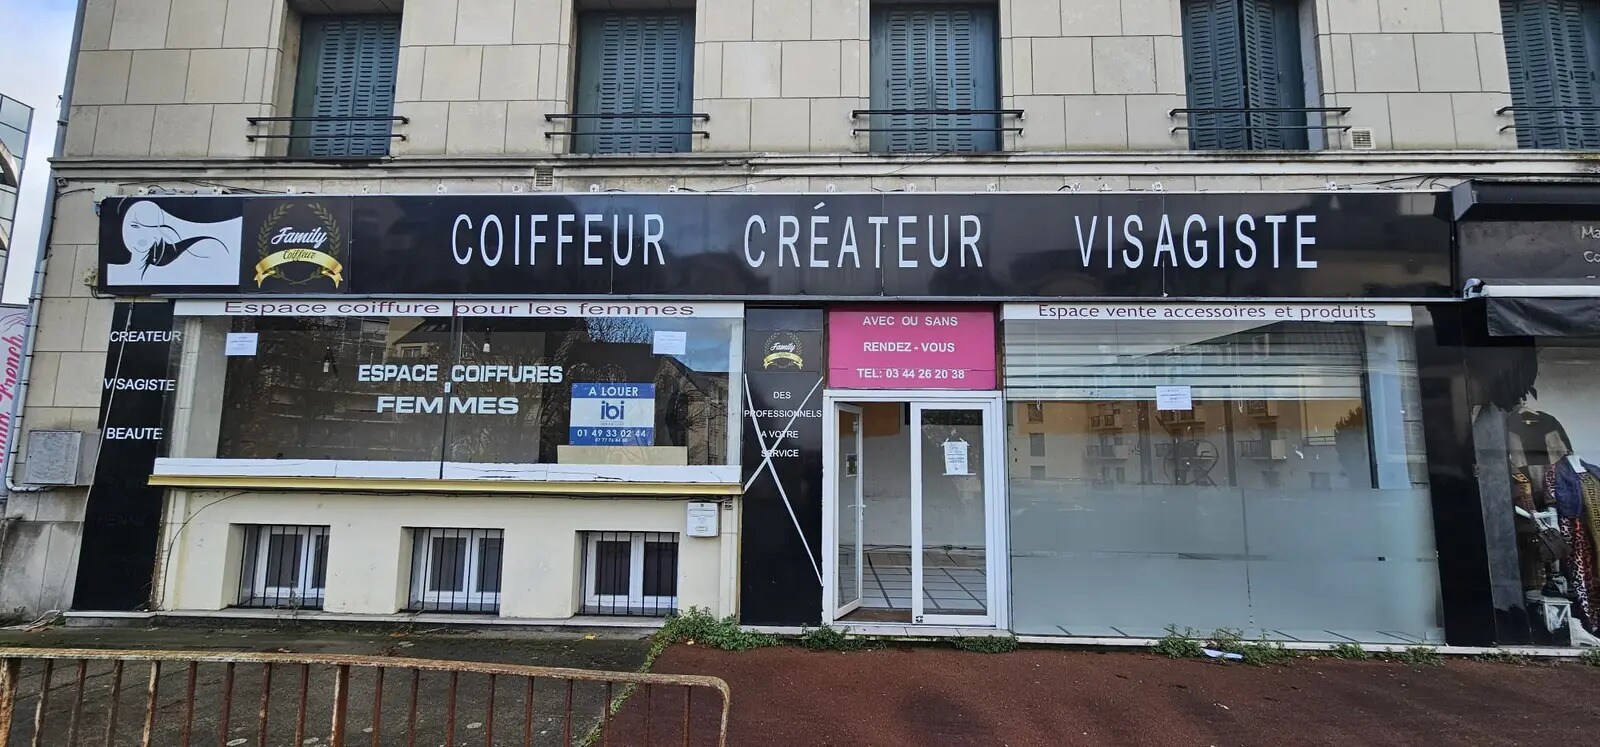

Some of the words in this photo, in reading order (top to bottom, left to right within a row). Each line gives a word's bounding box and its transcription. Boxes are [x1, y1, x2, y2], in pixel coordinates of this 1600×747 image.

[270, 226, 328, 249] Family
[452, 214, 665, 267] COIFFEUR
[744, 201, 983, 268] CRÉATEUR
[1074, 213, 1317, 269] VISAGISTE
[225, 301, 327, 316] Espace
[337, 301, 440, 314] coiffure
[454, 303, 518, 317] pour
[529, 302, 567, 315] les
[579, 302, 694, 316] femmes
[1039, 304, 1099, 320] Espace
[1106, 306, 1157, 318] vente
[1164, 305, 1266, 318] accessoires
[1274, 306, 1293, 318] et
[1301, 305, 1376, 321] produits
[863, 316, 895, 326] AVEC
[902, 316, 918, 326] OU
[925, 316, 958, 326] SANS
[109, 330, 181, 342] CREATEUR
[863, 342, 912, 352] RENDEZ
[921, 342, 955, 352] VOUS
[358, 364, 439, 382] ESPACE
[451, 364, 563, 383] COIFFURES
[857, 368, 882, 378] TEL:
[886, 369, 899, 379] 03
[902, 369, 915, 379] 44
[918, 369, 932, 379] 26
[935, 369, 948, 379] 20
[952, 369, 965, 379] 38
[104, 378, 176, 391] VSAGISTE
[588, 387, 597, 396] A
[601, 387, 639, 396] LOUER
[773, 391, 791, 399] DES
[601, 400, 625, 420] ibi
[744, 410, 822, 418] PROFESSIONNELS
[106, 428, 163, 440] BEAUTE
[577, 429, 588, 437] 01
[591, 429, 603, 437] 49
[620, 430, 632, 438] 02
[635, 430, 646, 438] 44
[761, 430, 767, 438] A
